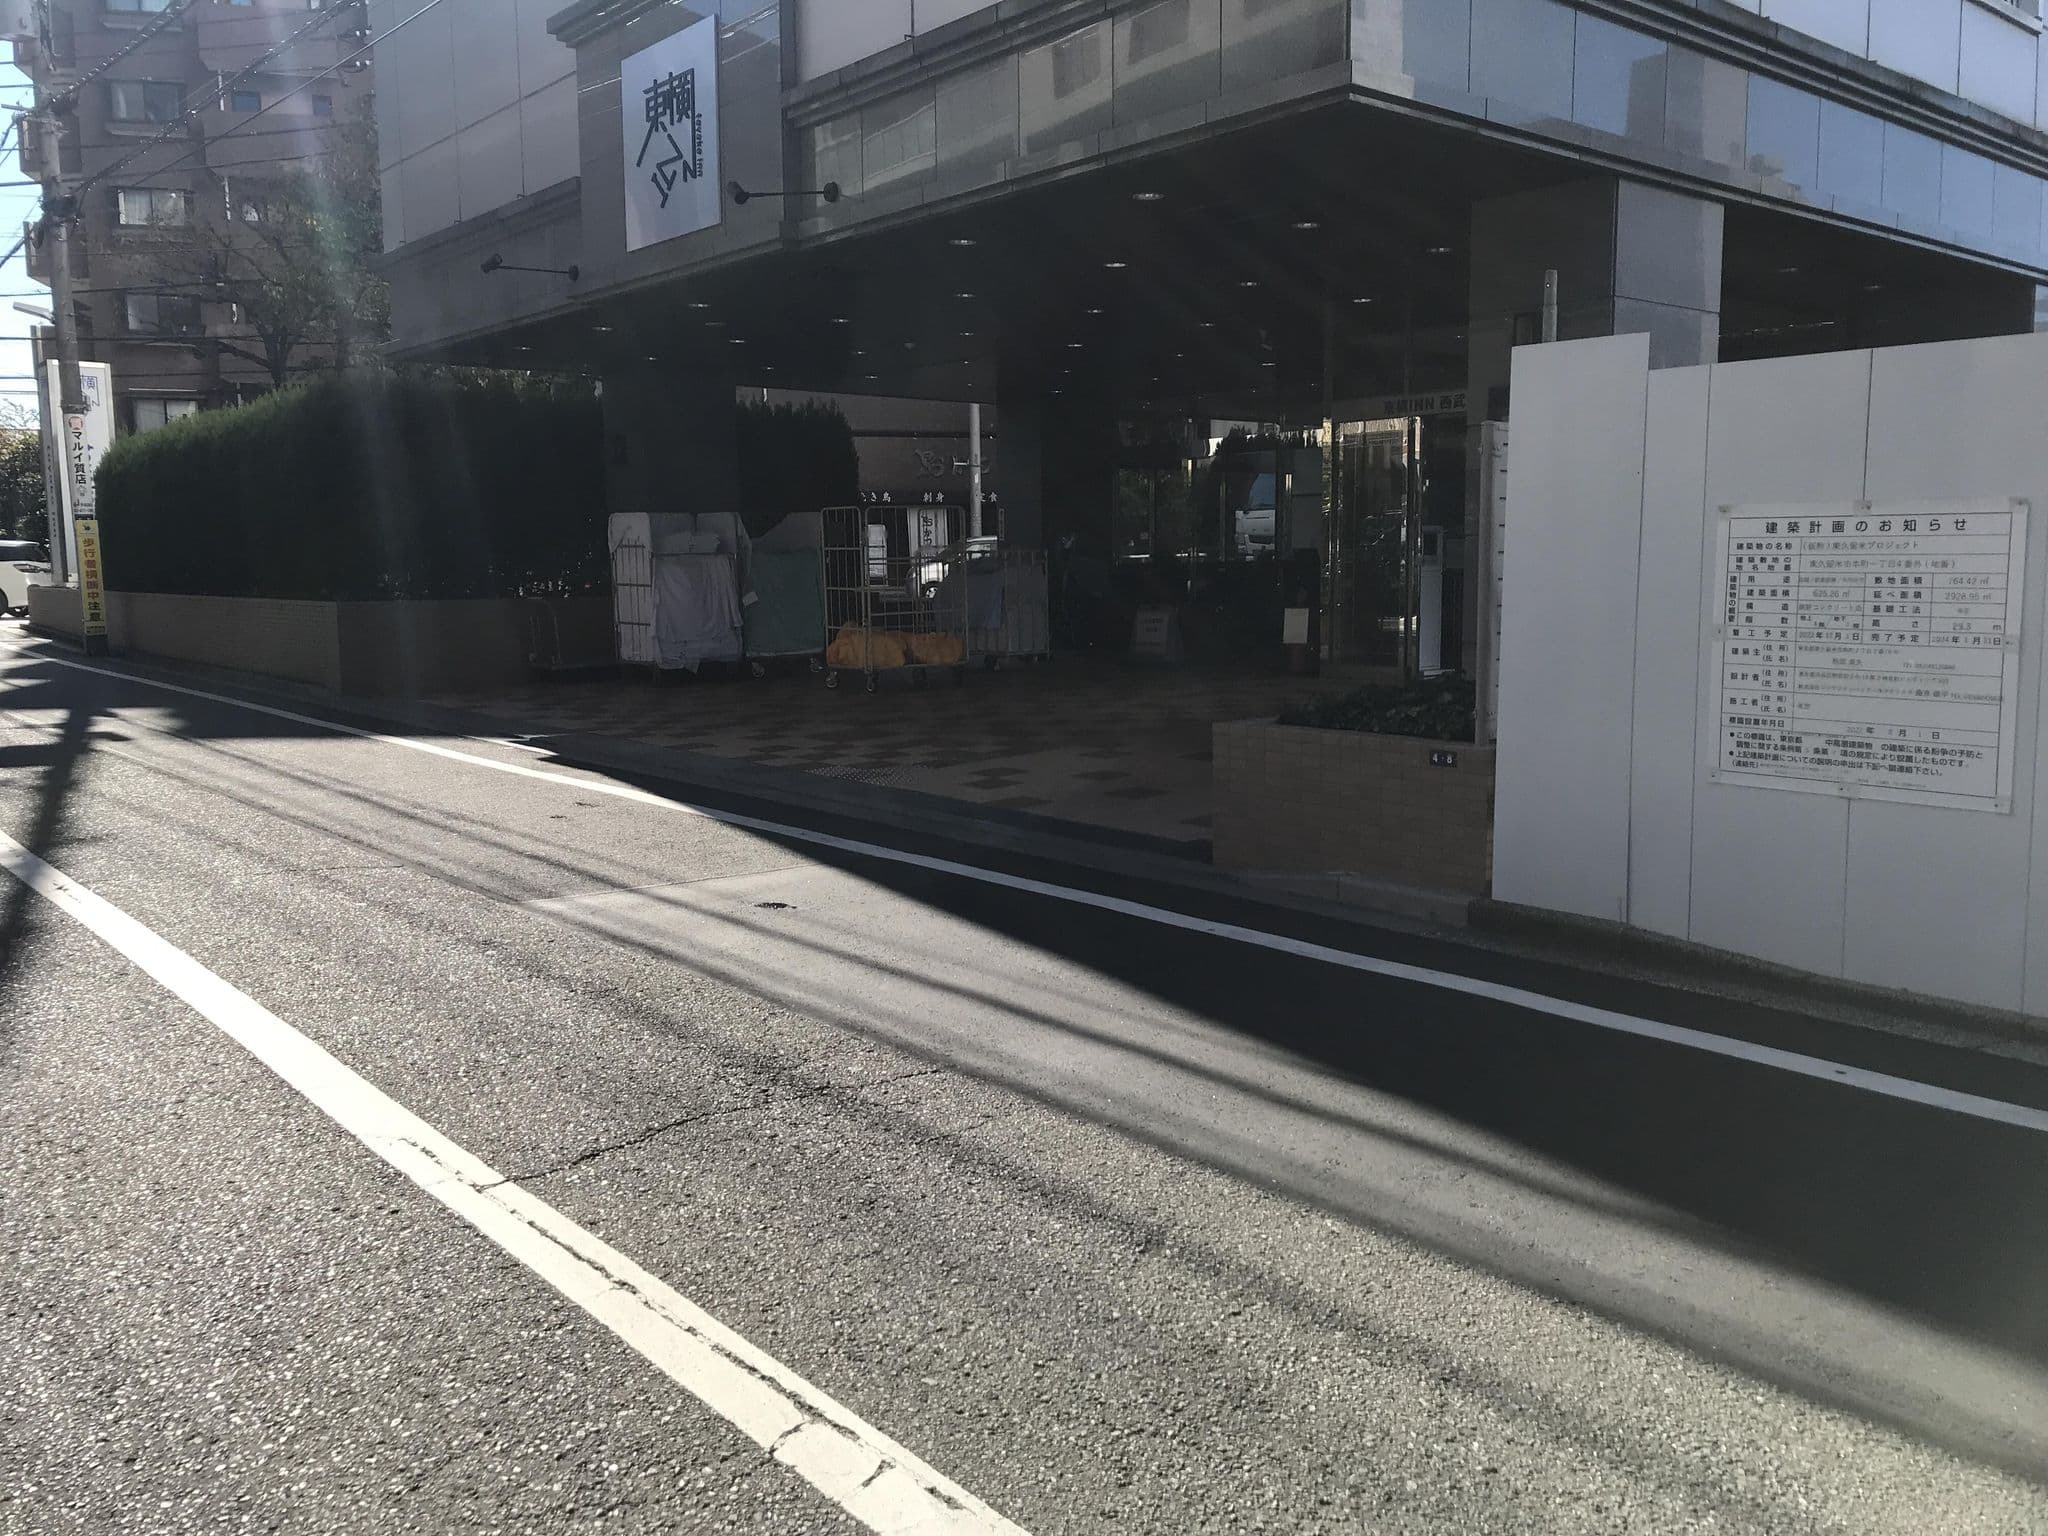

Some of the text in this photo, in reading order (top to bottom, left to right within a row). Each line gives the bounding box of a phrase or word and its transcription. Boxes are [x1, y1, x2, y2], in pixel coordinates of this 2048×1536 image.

[1765, 518, 1968, 534] 建築計画のお知らせ
[1874, 576, 1922, 585] 敷地面積
